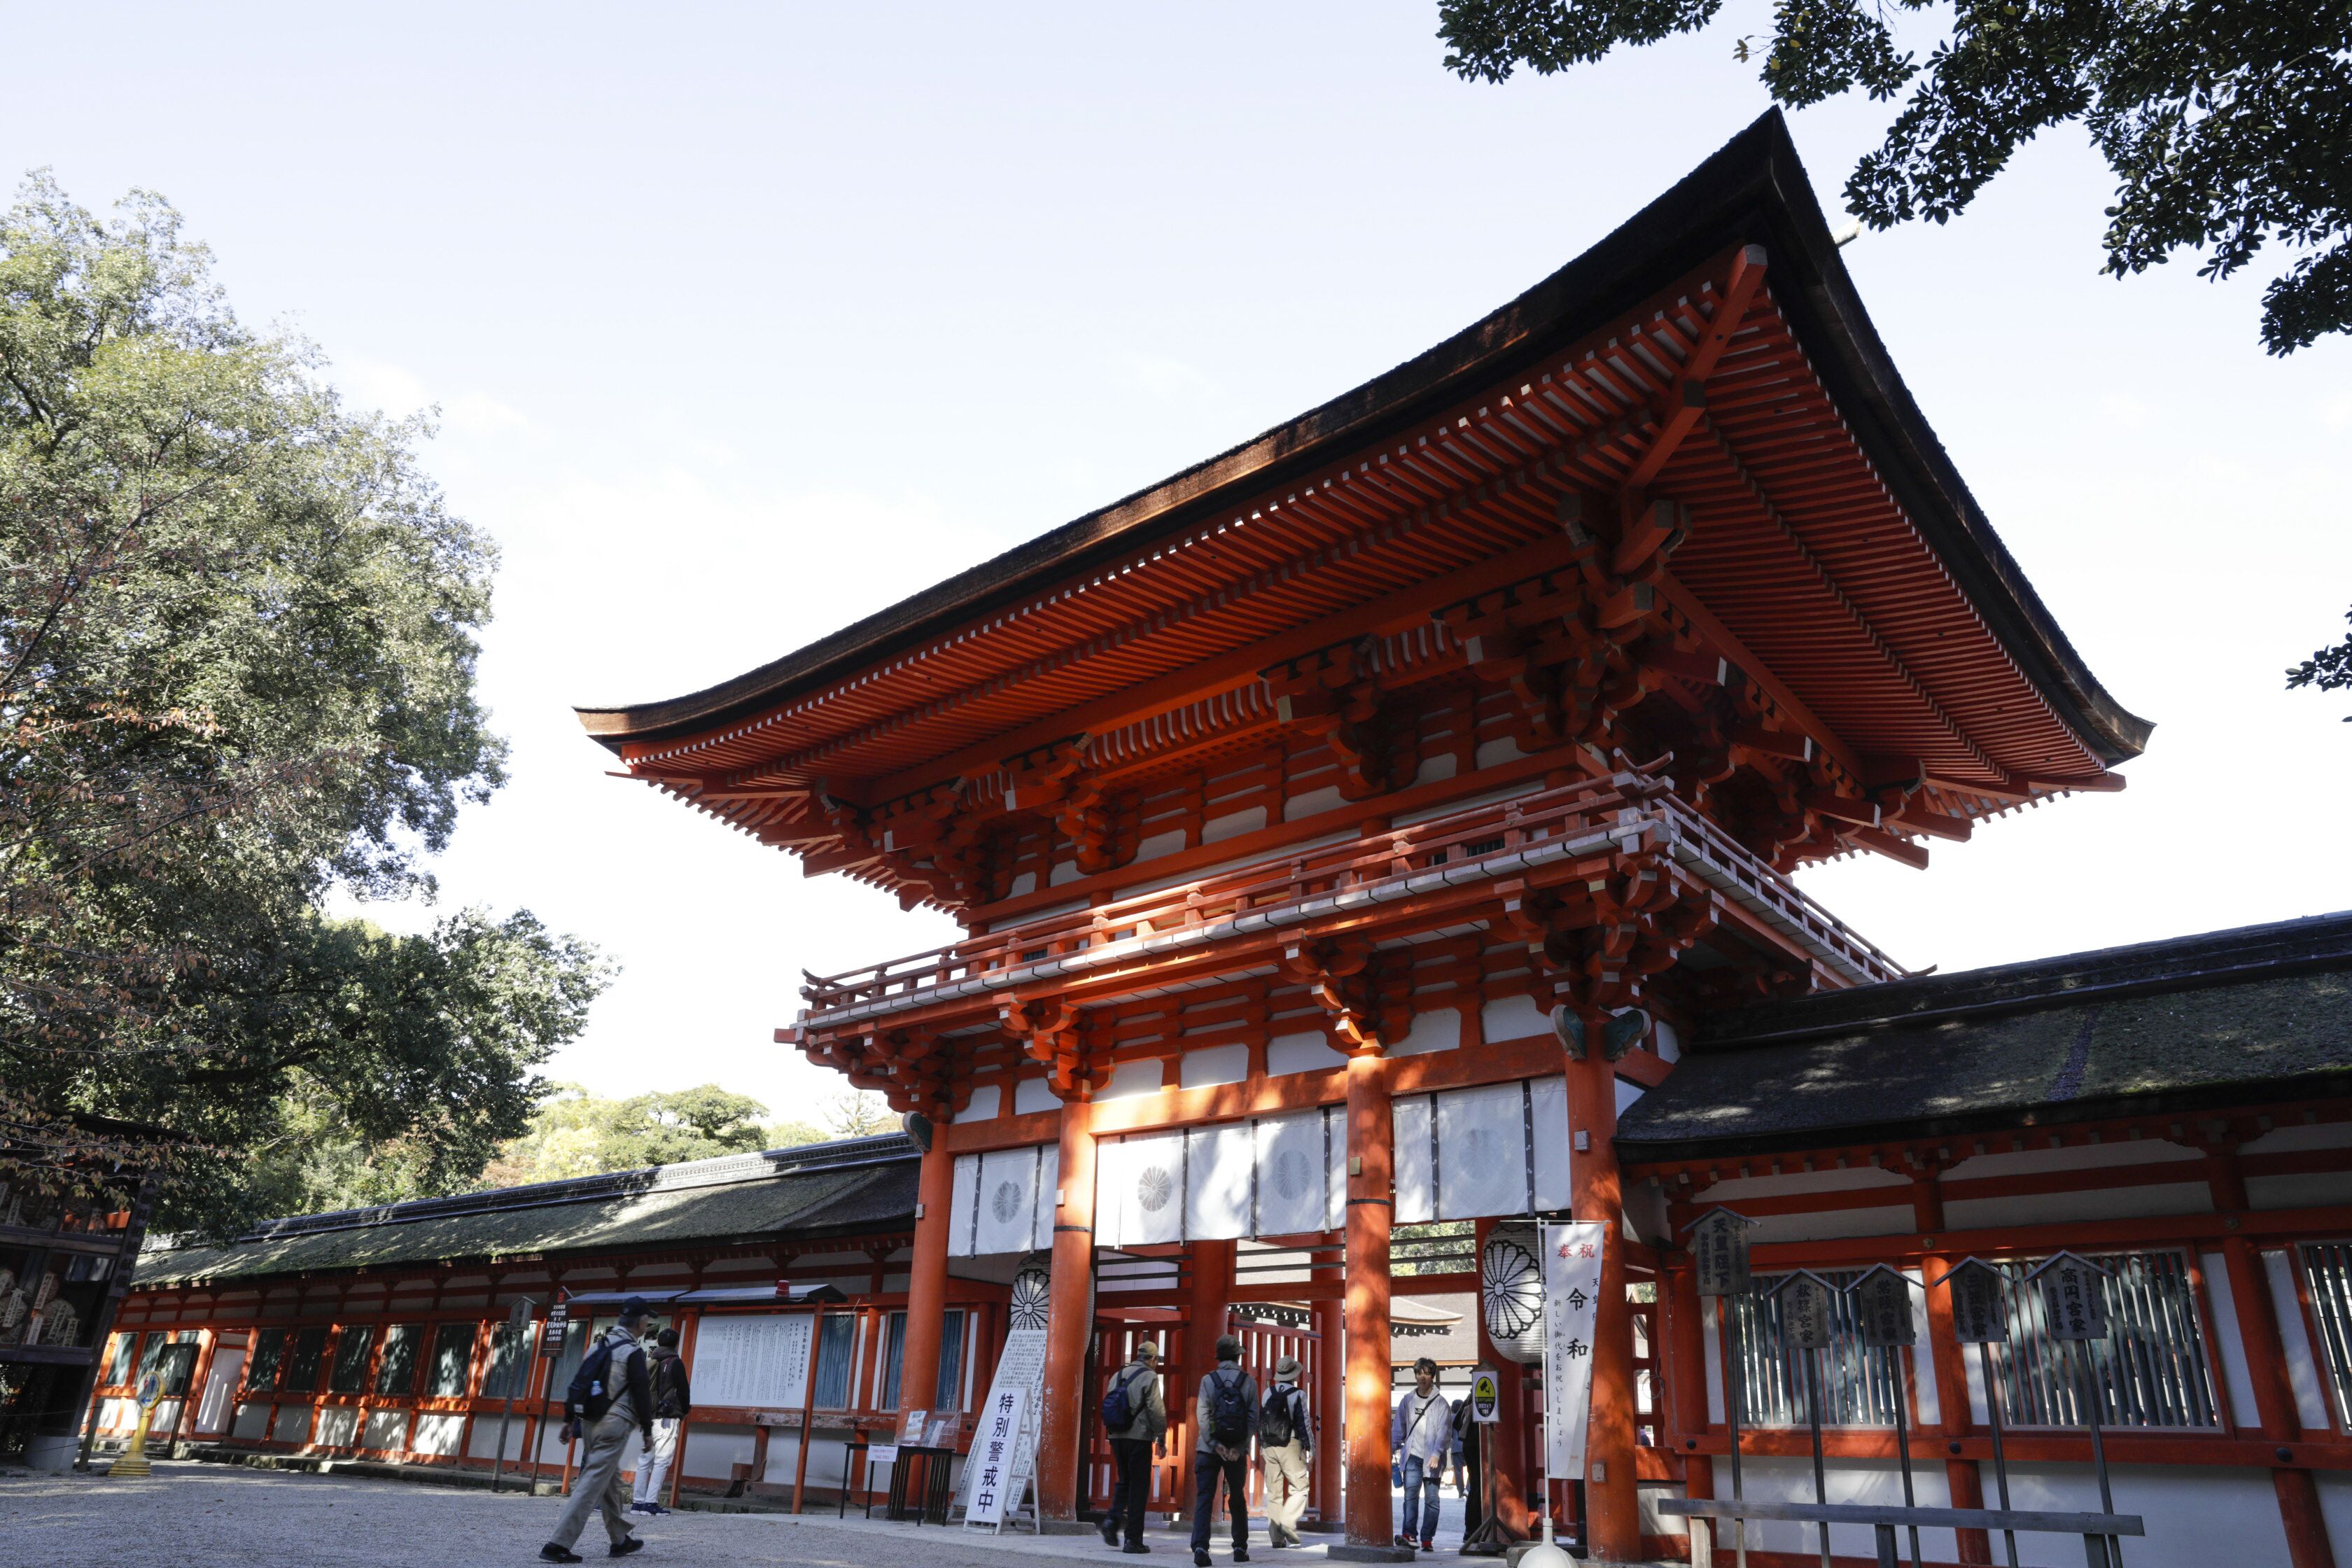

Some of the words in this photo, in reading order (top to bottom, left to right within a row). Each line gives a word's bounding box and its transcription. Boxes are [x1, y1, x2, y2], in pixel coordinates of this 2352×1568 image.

[1558, 1243, 1595, 1259] 奉祝
[1713, 1218, 1730, 1288] 天皇陛下
[1567, 1287, 1588, 1359] 令和
[1796, 1283, 1814, 1343] 秋篠宮家
[2060, 1268, 2087, 1333] 高円宮家
[1554, 1299, 1563, 1448] 新しい御代をお祝いしましょう
[978, 1393, 1014, 1513] 特別警戒中
